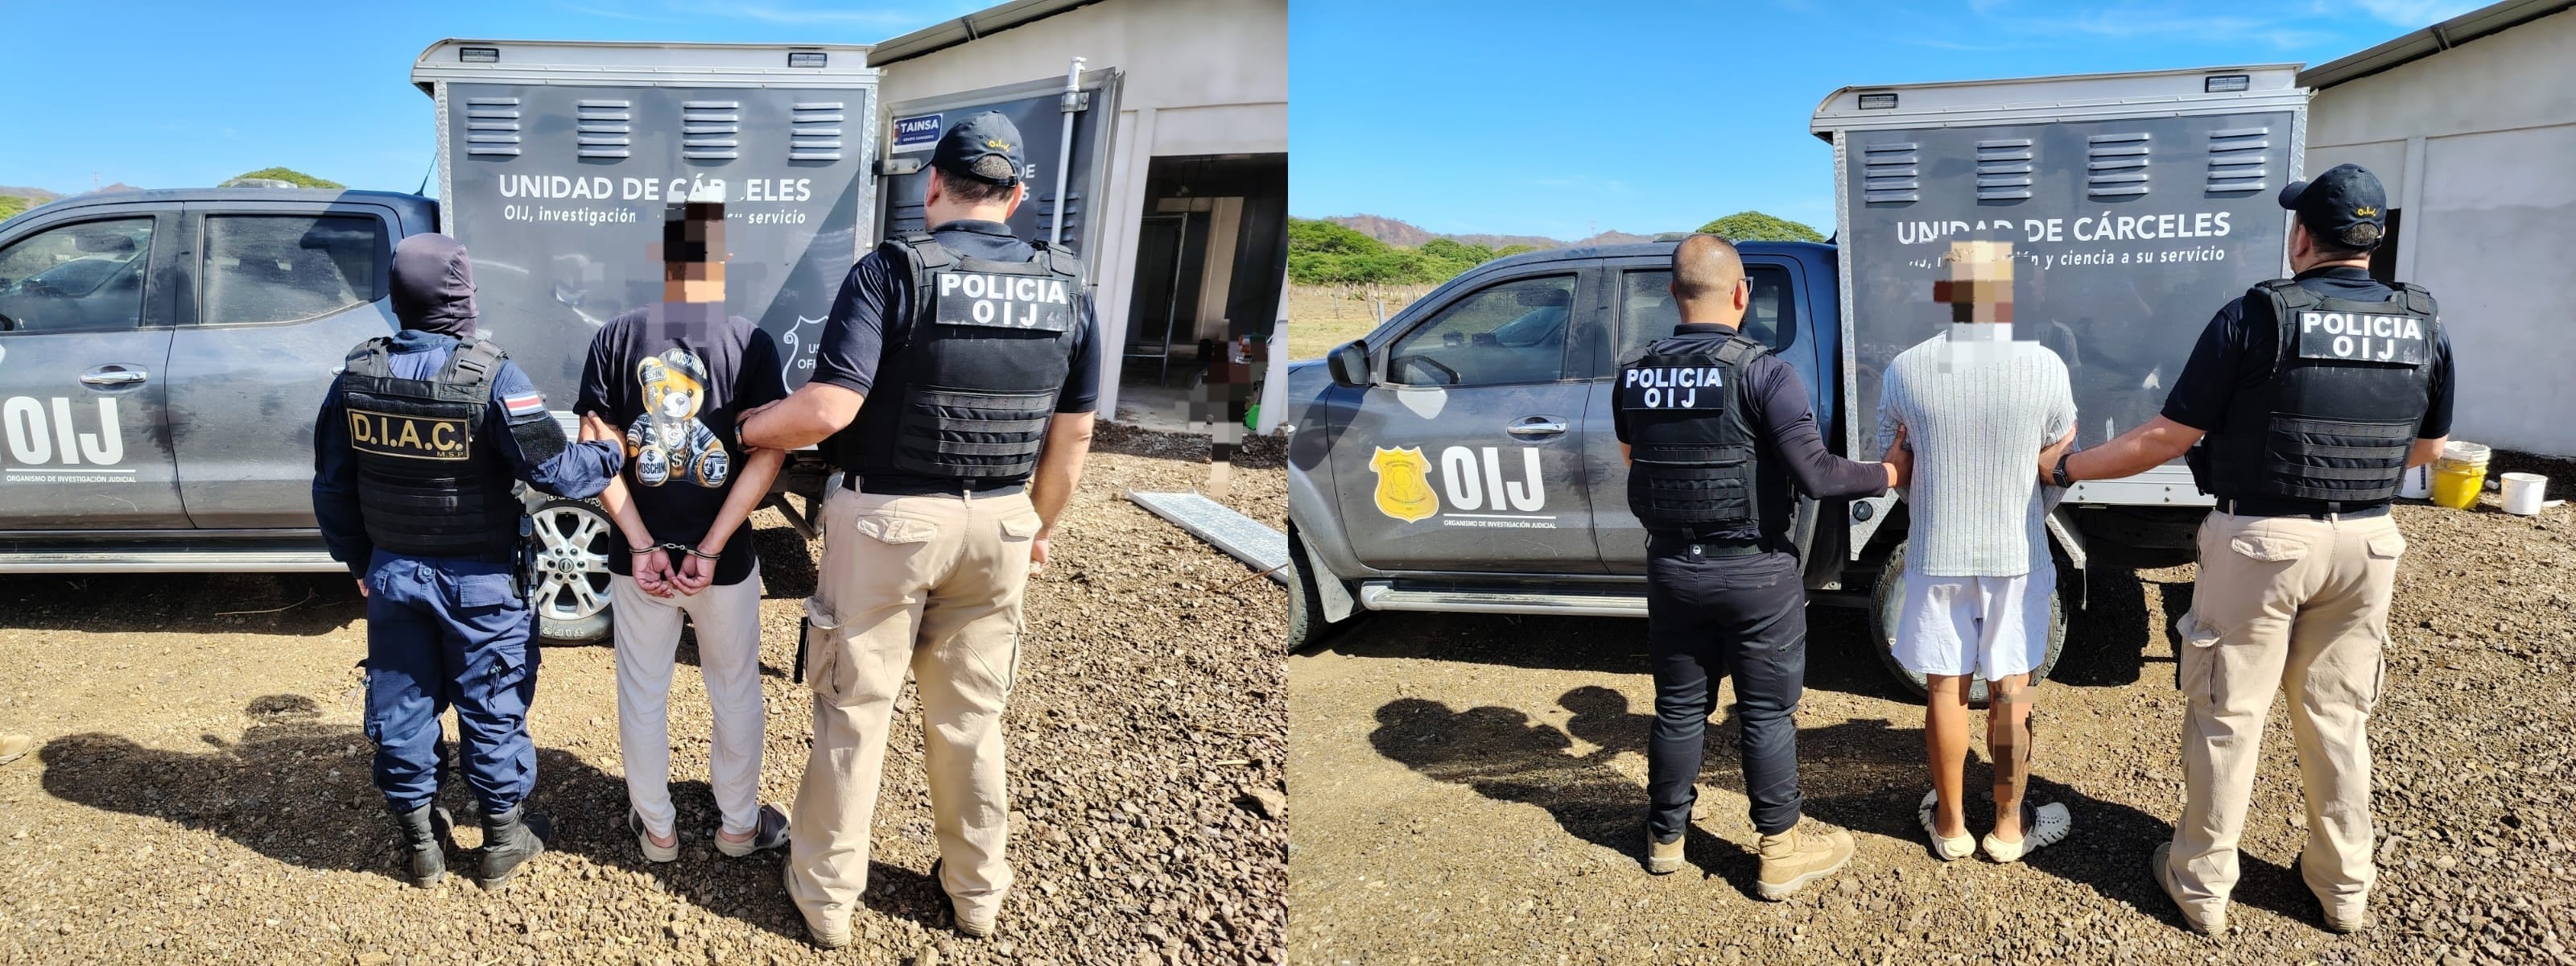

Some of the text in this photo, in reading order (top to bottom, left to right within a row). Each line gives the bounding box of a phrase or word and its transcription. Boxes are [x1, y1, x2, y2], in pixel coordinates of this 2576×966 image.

[900, 118, 939, 134] TAINSA
[1021, 163, 1036, 179] E
[499, 174, 613, 200] UNIDAD
[623, 177, 659, 200] DE
[504, 204, 806, 227] OIJ, investigación servicio
[2025, 218, 2063, 242] DE
[2073, 210, 2231, 242] CÁRCELES
[2044, 254, 2054, 270] y
[2060, 249, 2115, 266] ciencia
[2121, 252, 2130, 264] a
[2136, 251, 2153, 264] su
[2160, 245, 2226, 263] servicio
[941, 273, 1067, 304] POLICIA
[2303, 312, 2422, 341] POLICIA
[669, 350, 704, 375] MOSCHINO
[1625, 368, 1723, 388] POLICIA
[3, 396, 124, 465] OIJ
[352, 413, 464, 451] D.I.A.C.
[57, 474, 107, 483] INVESTIGACIÓN
[1441, 445, 1546, 512] OIJ
[1488, 520, 1530, 528] INVESTIGACIÓN
